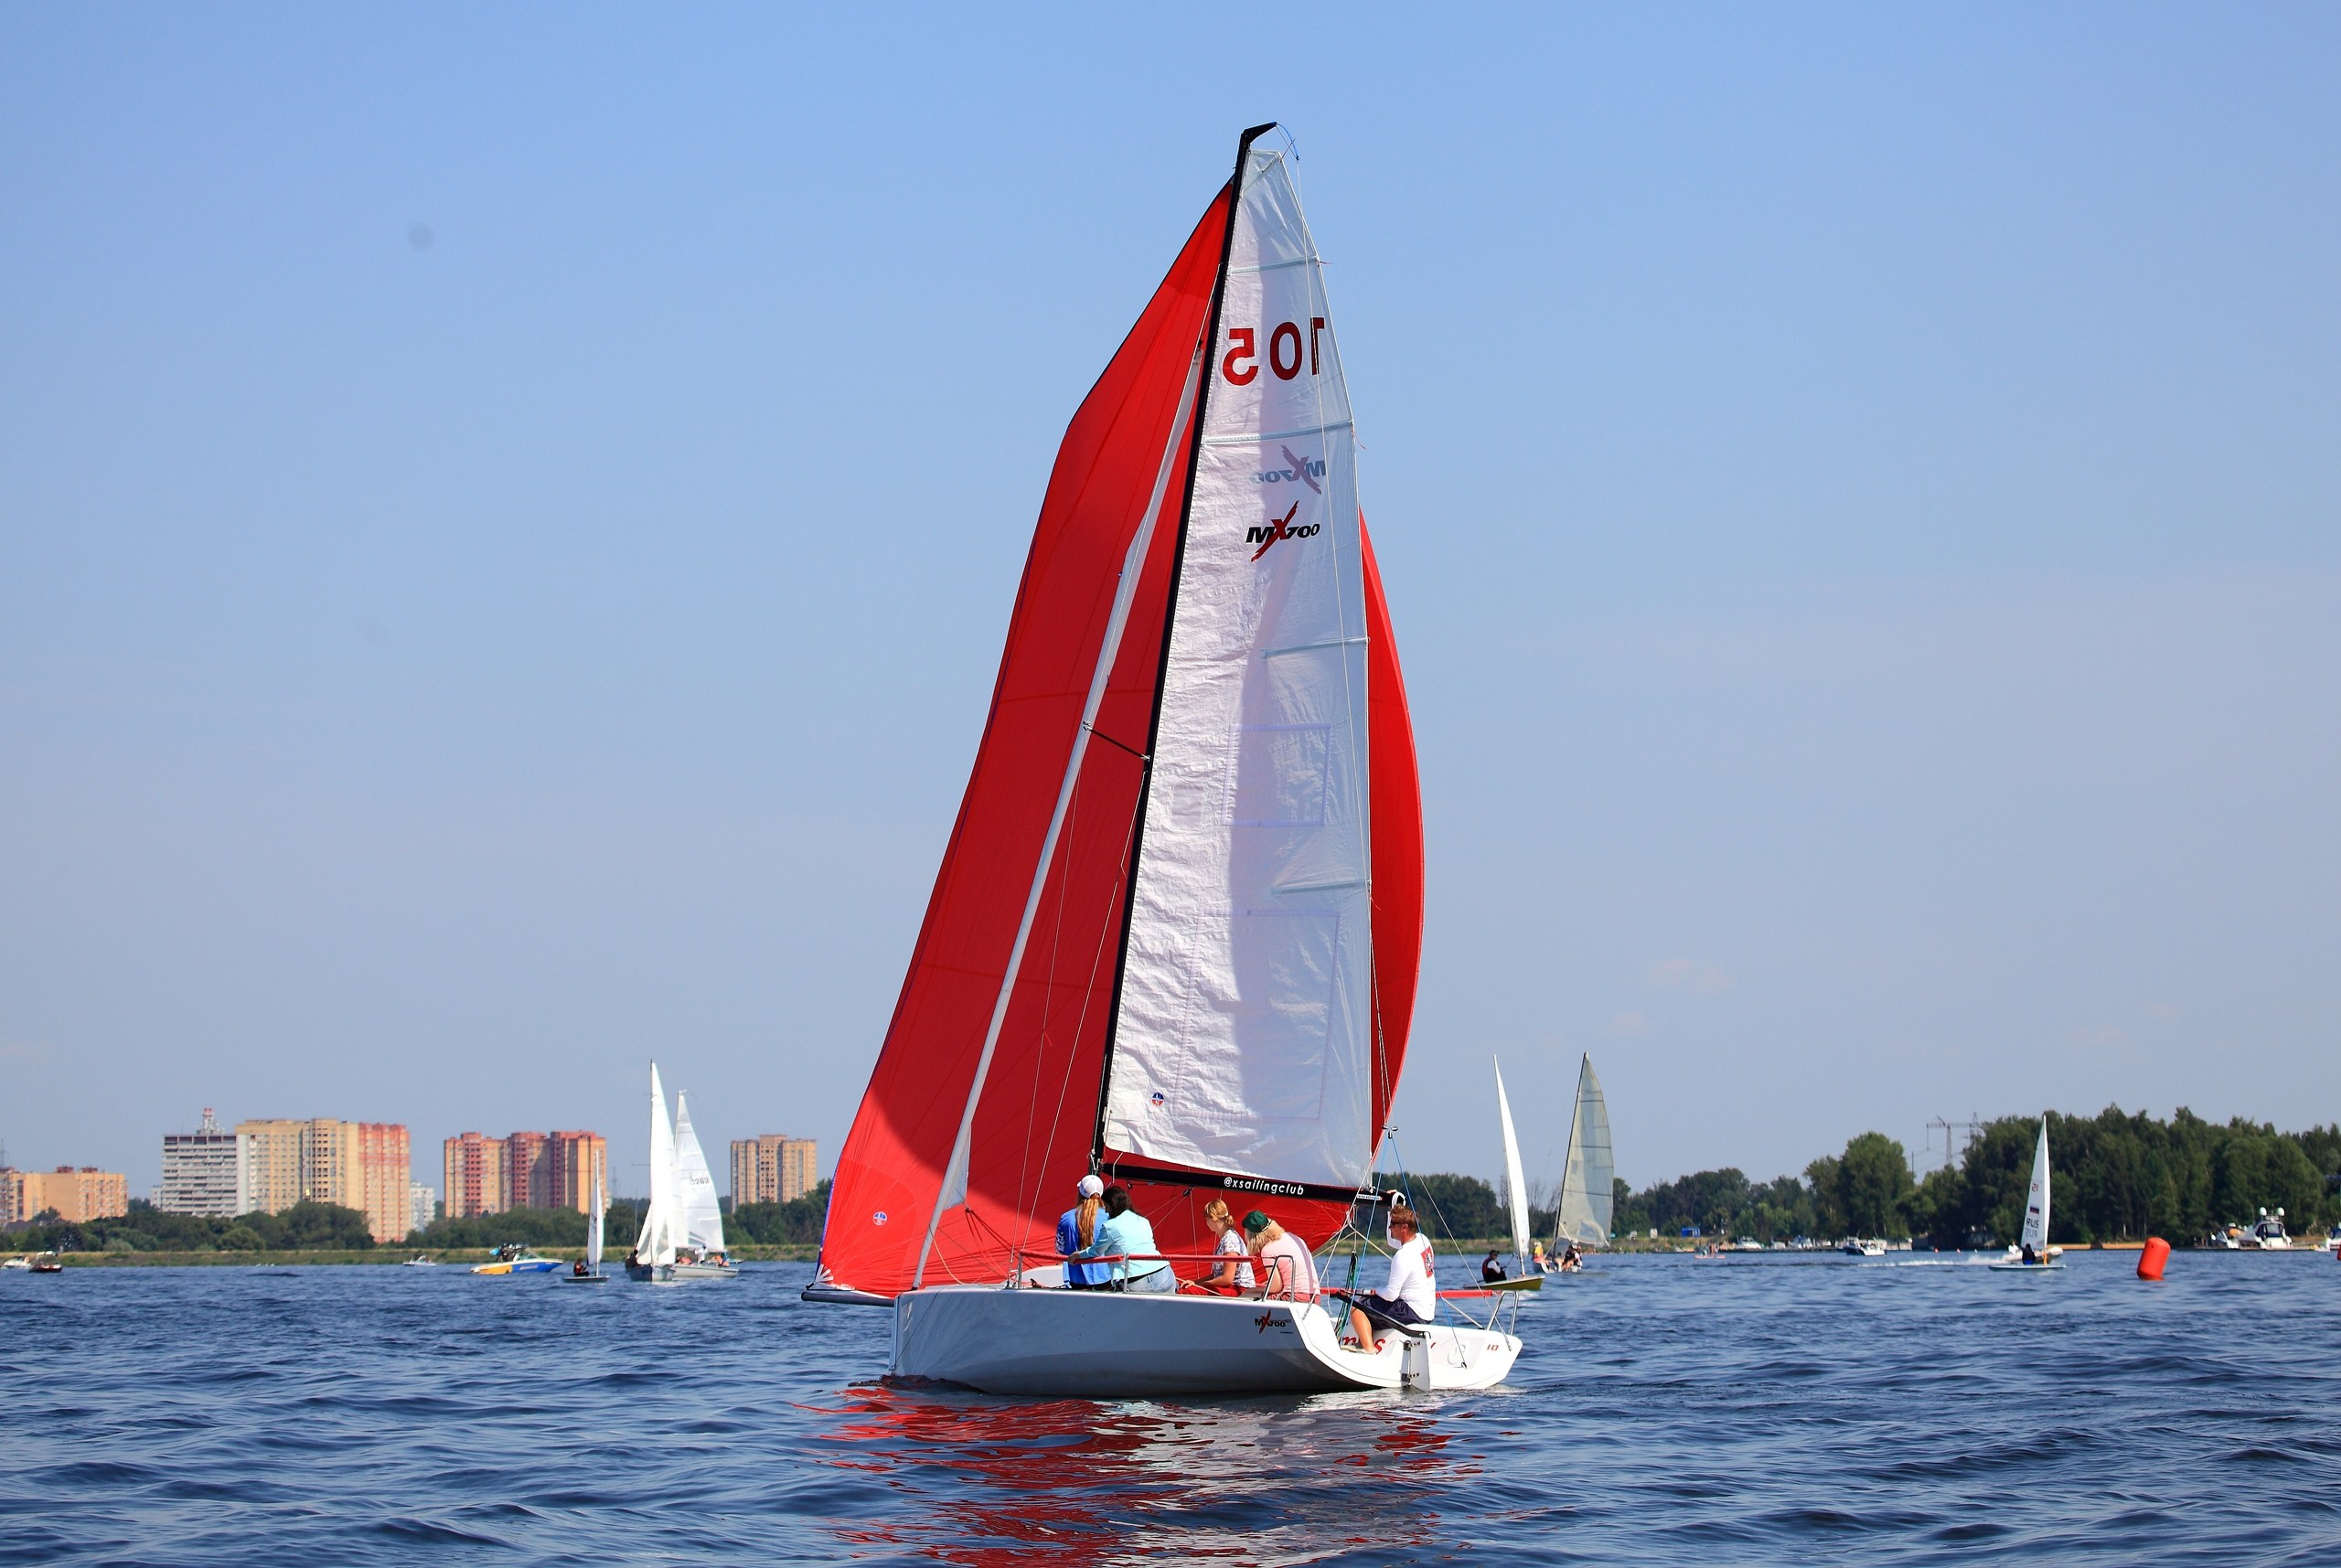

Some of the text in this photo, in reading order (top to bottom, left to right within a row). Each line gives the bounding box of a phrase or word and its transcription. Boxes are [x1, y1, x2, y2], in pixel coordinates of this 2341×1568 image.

[1245, 500, 1320, 562] MX700
[1224, 1177, 1304, 1195] @xsailingclub
[2026, 1217, 2039, 1229] RUS
